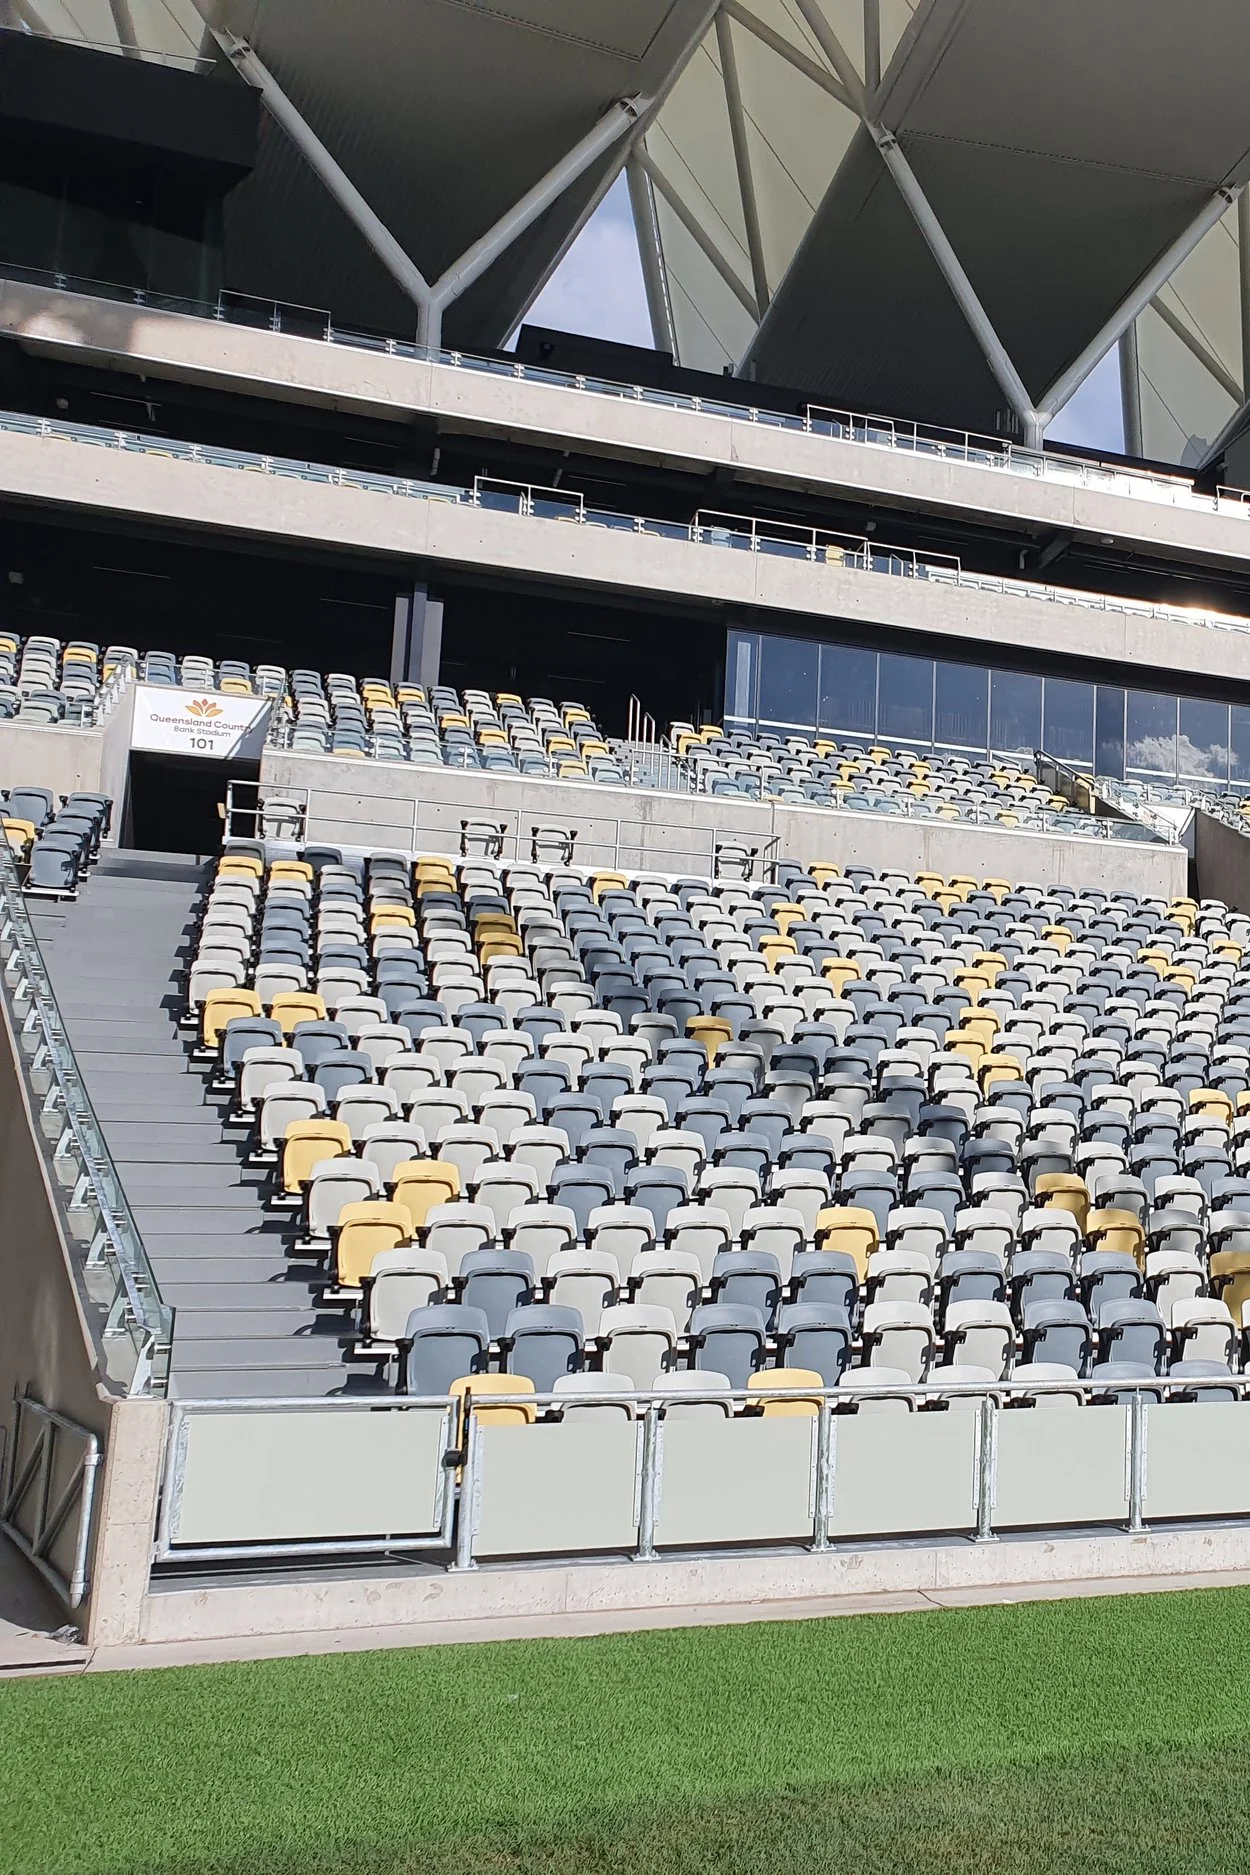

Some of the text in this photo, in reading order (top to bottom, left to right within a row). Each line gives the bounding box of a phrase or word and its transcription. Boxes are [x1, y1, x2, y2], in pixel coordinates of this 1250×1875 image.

[150, 713, 212, 727] Queensland
[173, 725, 231, 737] Bank Stadium
[190, 738, 214, 750] 101
